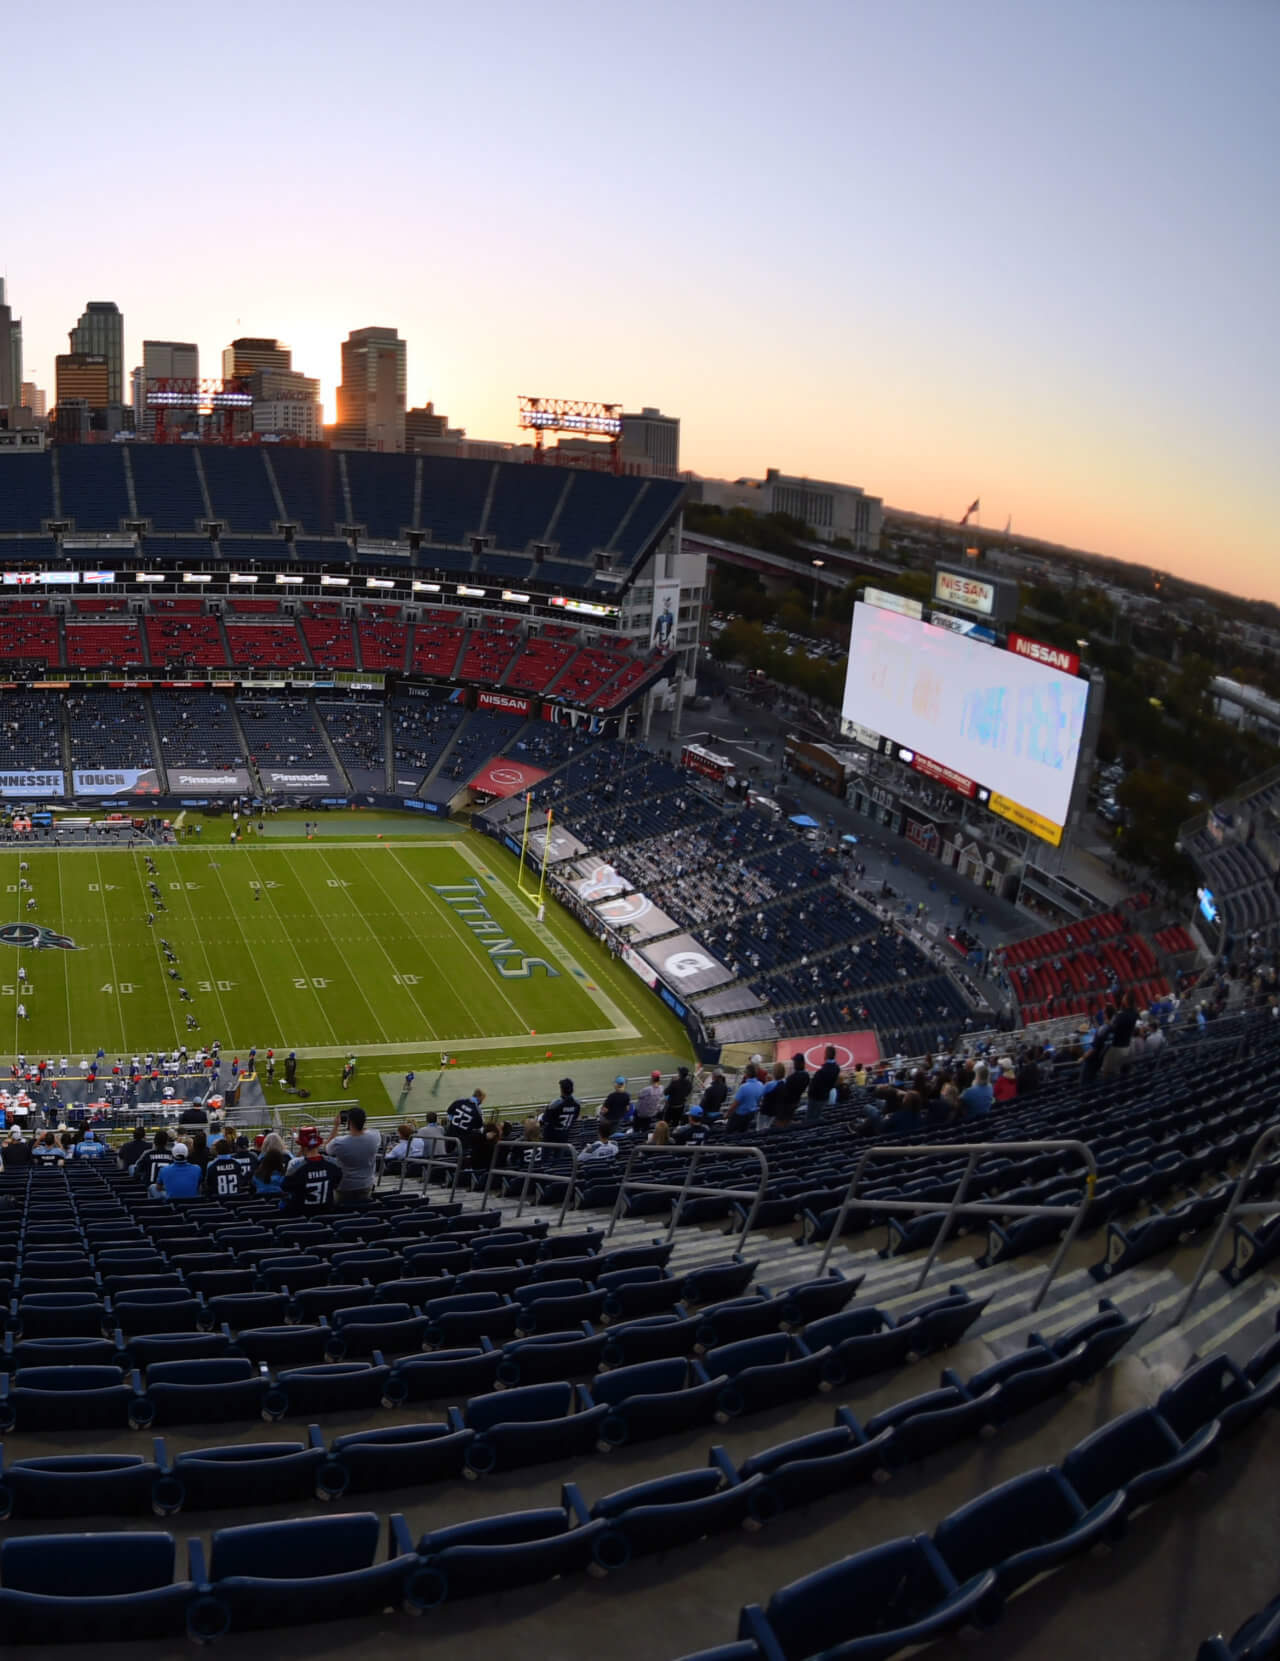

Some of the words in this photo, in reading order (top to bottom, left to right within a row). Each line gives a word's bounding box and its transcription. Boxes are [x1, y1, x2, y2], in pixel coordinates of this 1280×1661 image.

[941, 576, 988, 599] NISSAN
[1016, 639, 1070, 669] NISSAN
[480, 694, 527, 710] NISSAN
[78, 774, 125, 786] TOUGH
[179, 775, 237, 784] Pinnacle
[271, 773, 328, 782] Pinnacle
[427, 878, 561, 979] TITANS
[293, 978, 328, 989] 20
[393, 975, 419, 985] 10
[1, 985, 34, 995] 50
[101, 983, 133, 993] 40
[197, 981, 232, 992] 30
[451, 1108, 472, 1130] 22
[217, 1174, 238, 1194] 82
[304, 1180, 328, 1205] 31
